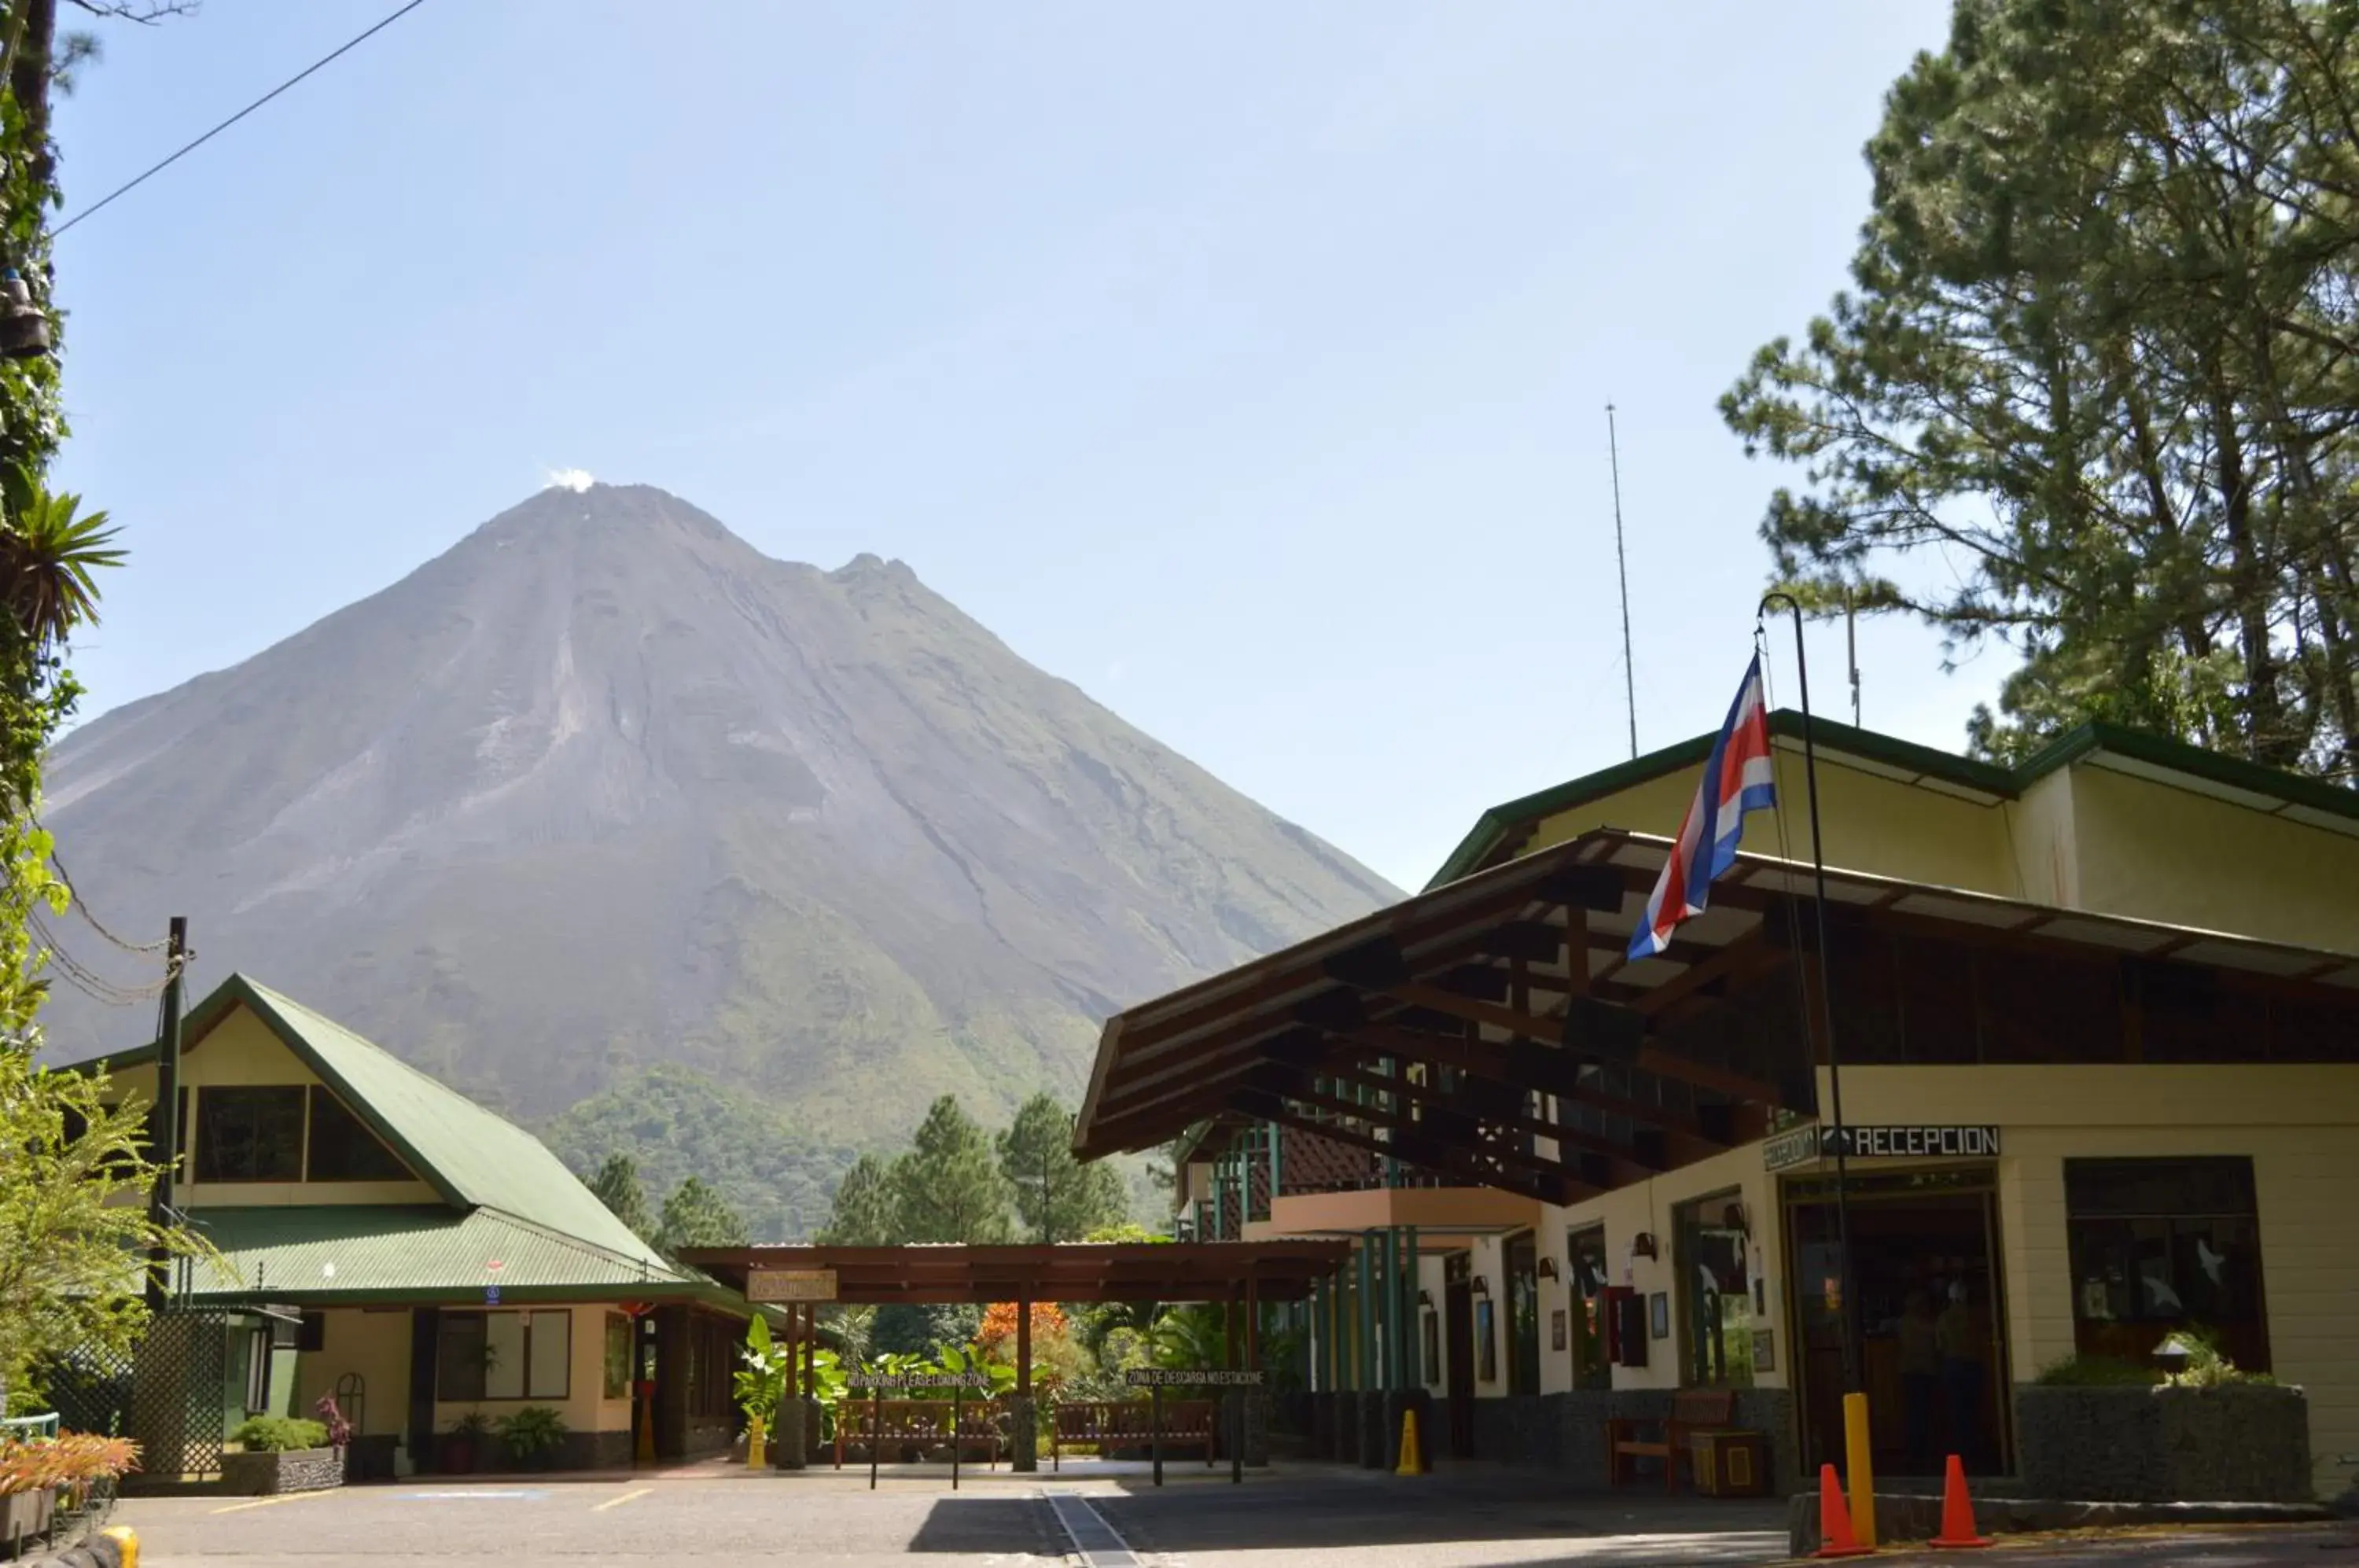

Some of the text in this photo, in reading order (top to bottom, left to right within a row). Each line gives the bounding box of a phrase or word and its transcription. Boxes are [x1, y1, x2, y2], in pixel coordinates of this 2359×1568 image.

[1856, 1128, 1998, 1154] RECEPCION
[1128, 1371, 1150, 1385] ZONA
[1152, 1371, 1163, 1385] DE
[1165, 1371, 1206, 1385] DESCARGA
[1208, 1371, 1219, 1385] NO
